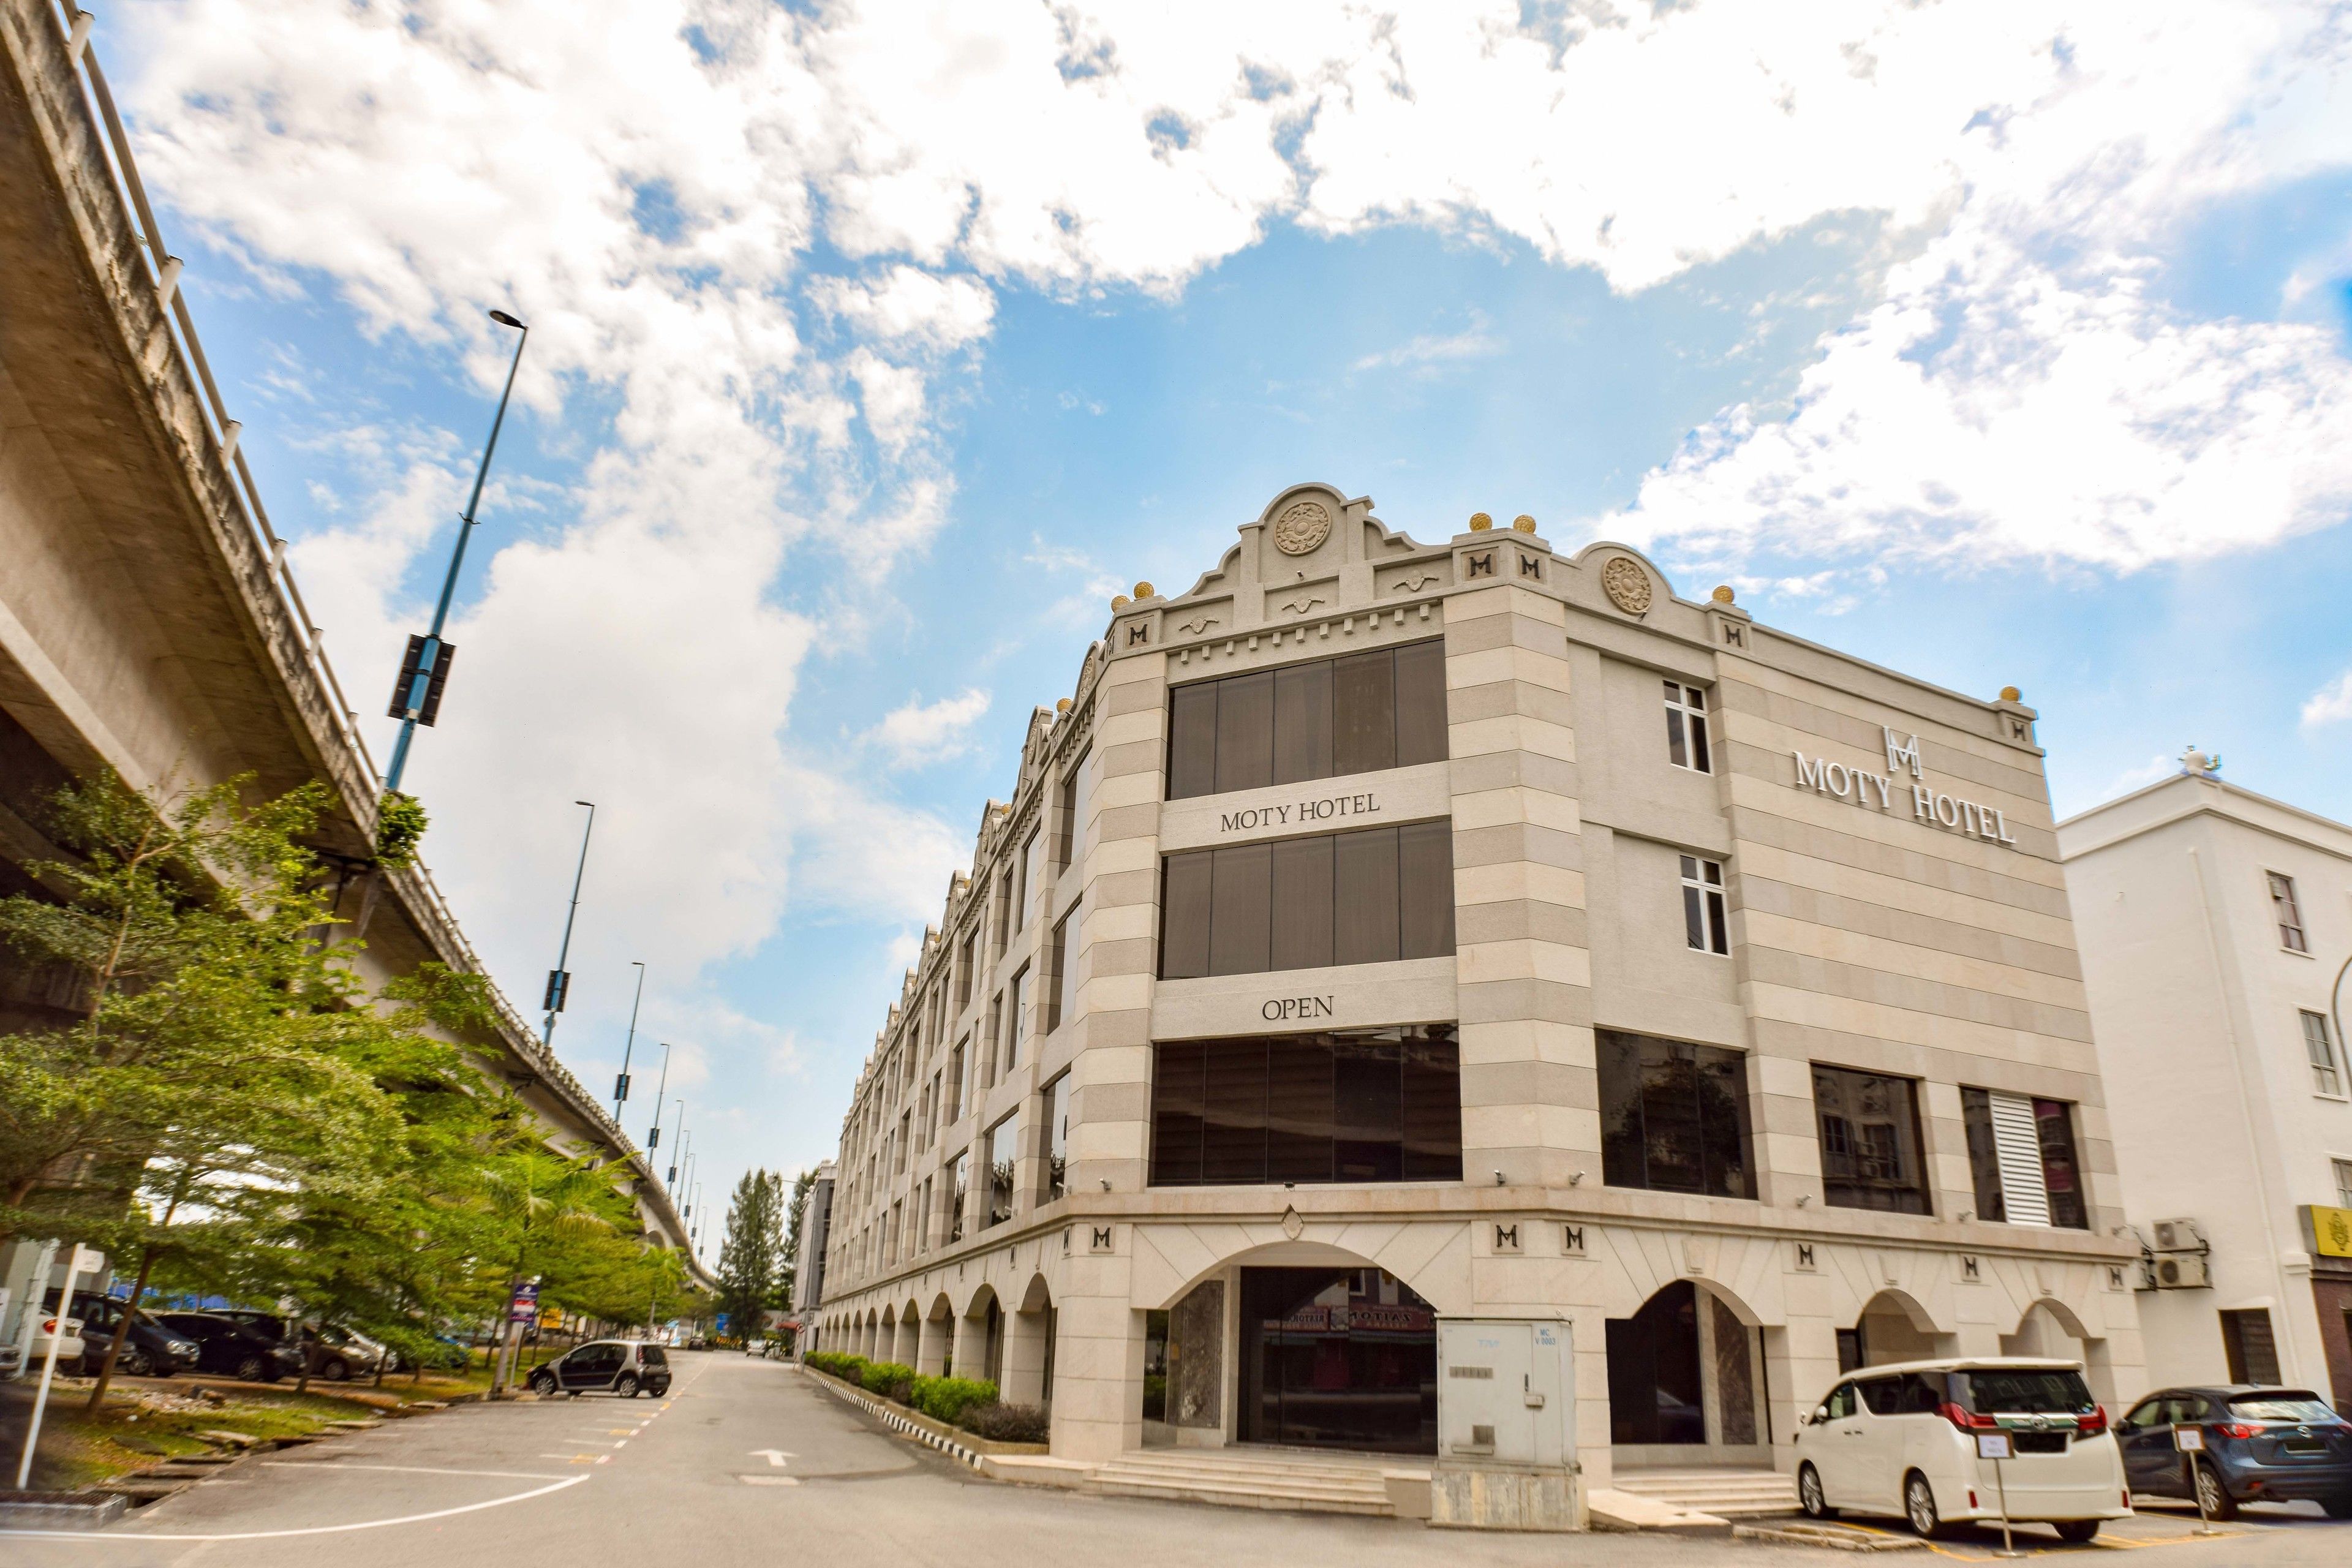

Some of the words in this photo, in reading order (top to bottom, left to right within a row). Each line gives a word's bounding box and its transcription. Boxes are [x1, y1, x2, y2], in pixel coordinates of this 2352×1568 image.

[1221, 805, 1291, 832] MOTY
[1298, 794, 1380, 821] HOTEL
[1792, 750, 1892, 809] MOTY
[1912, 785, 2016, 843] HOTEL
[1262, 995, 1334, 1020] OPEN
